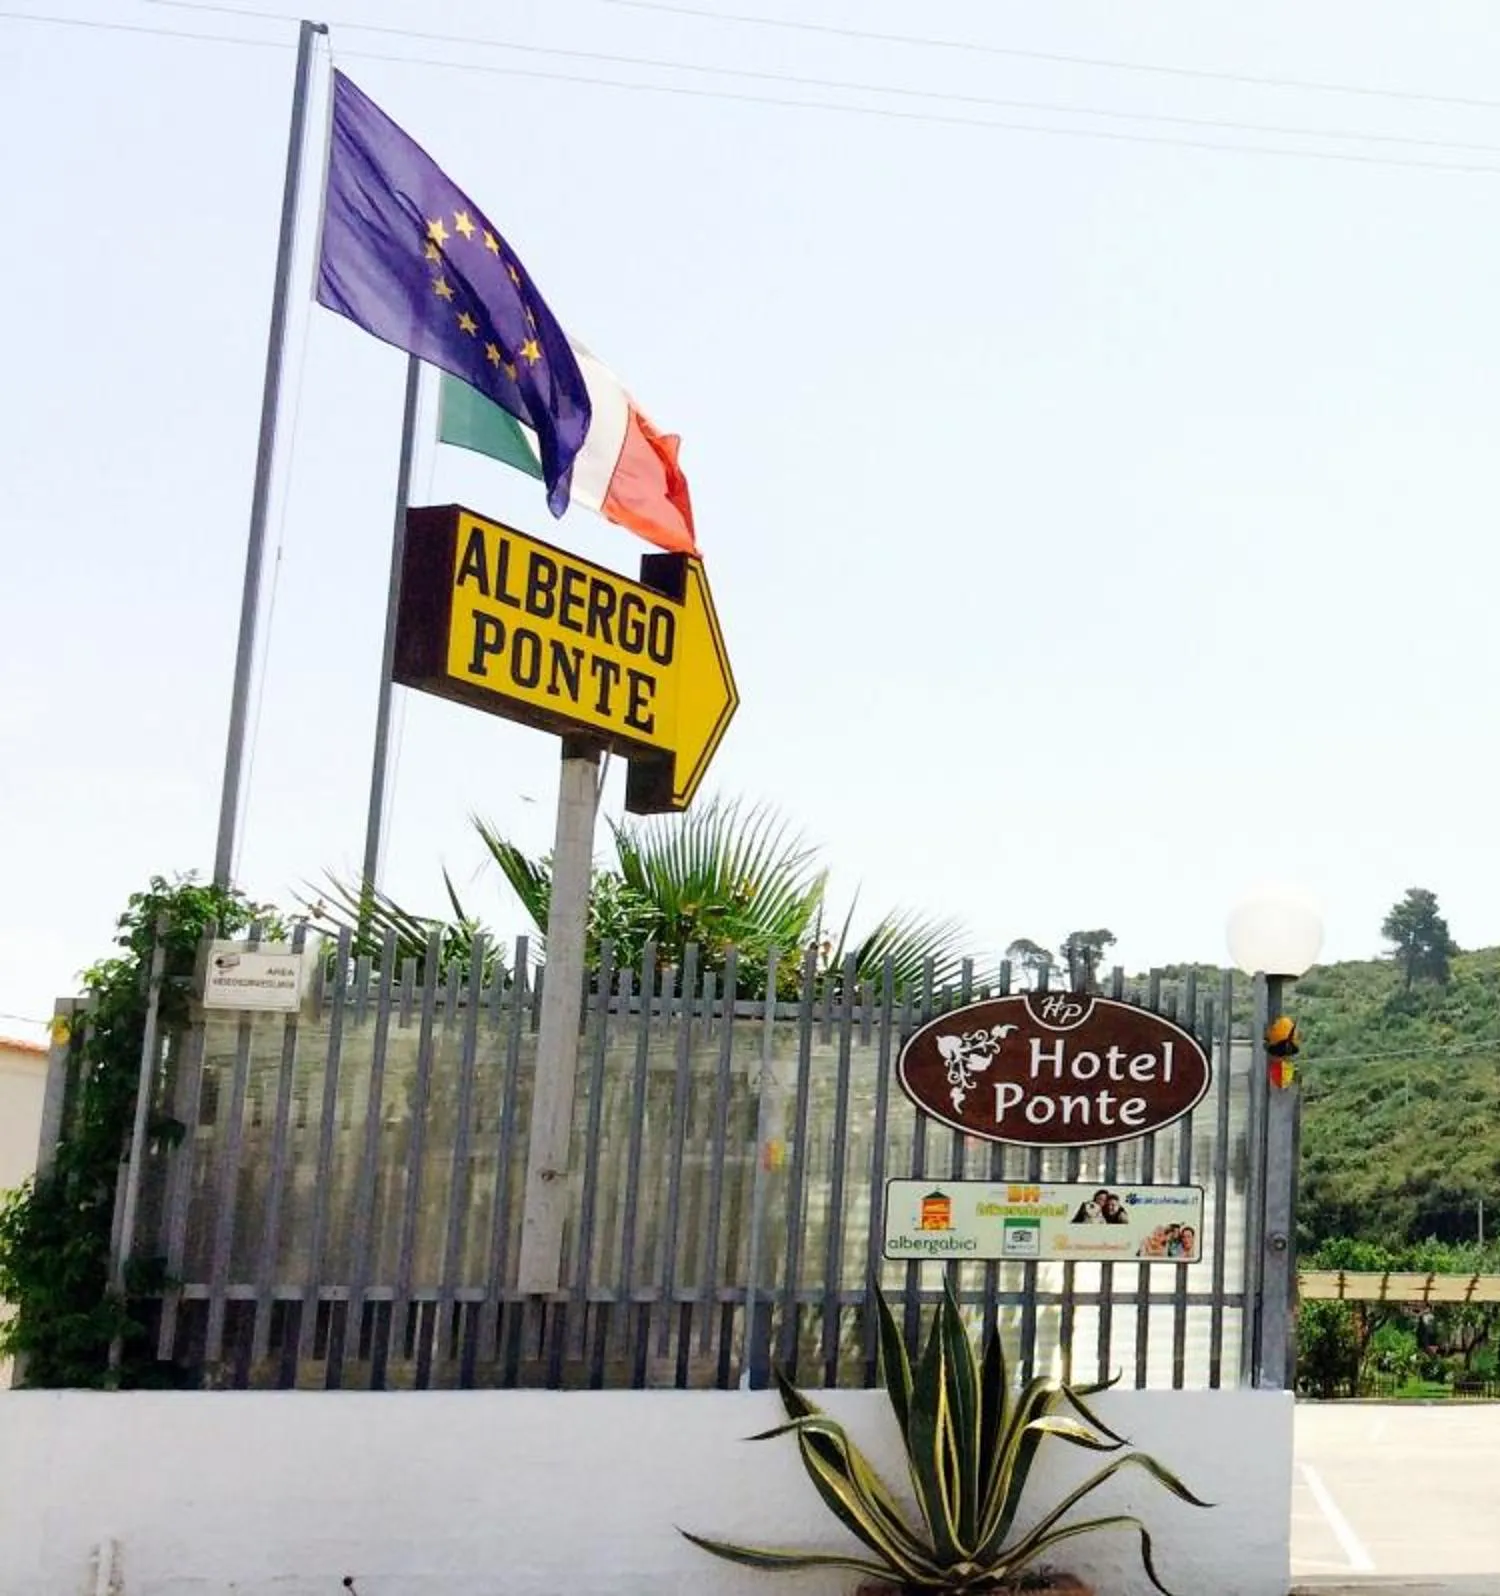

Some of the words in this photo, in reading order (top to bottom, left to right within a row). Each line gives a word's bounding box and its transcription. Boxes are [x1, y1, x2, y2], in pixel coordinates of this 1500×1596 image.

[457, 528, 676, 666] ALBERGO
[468, 609, 657, 734] PONTE
[1029, 1038, 1175, 1082] Hotel
[994, 1083, 1147, 1125] Ponte
[887, 1236, 977, 1254] albergabici
